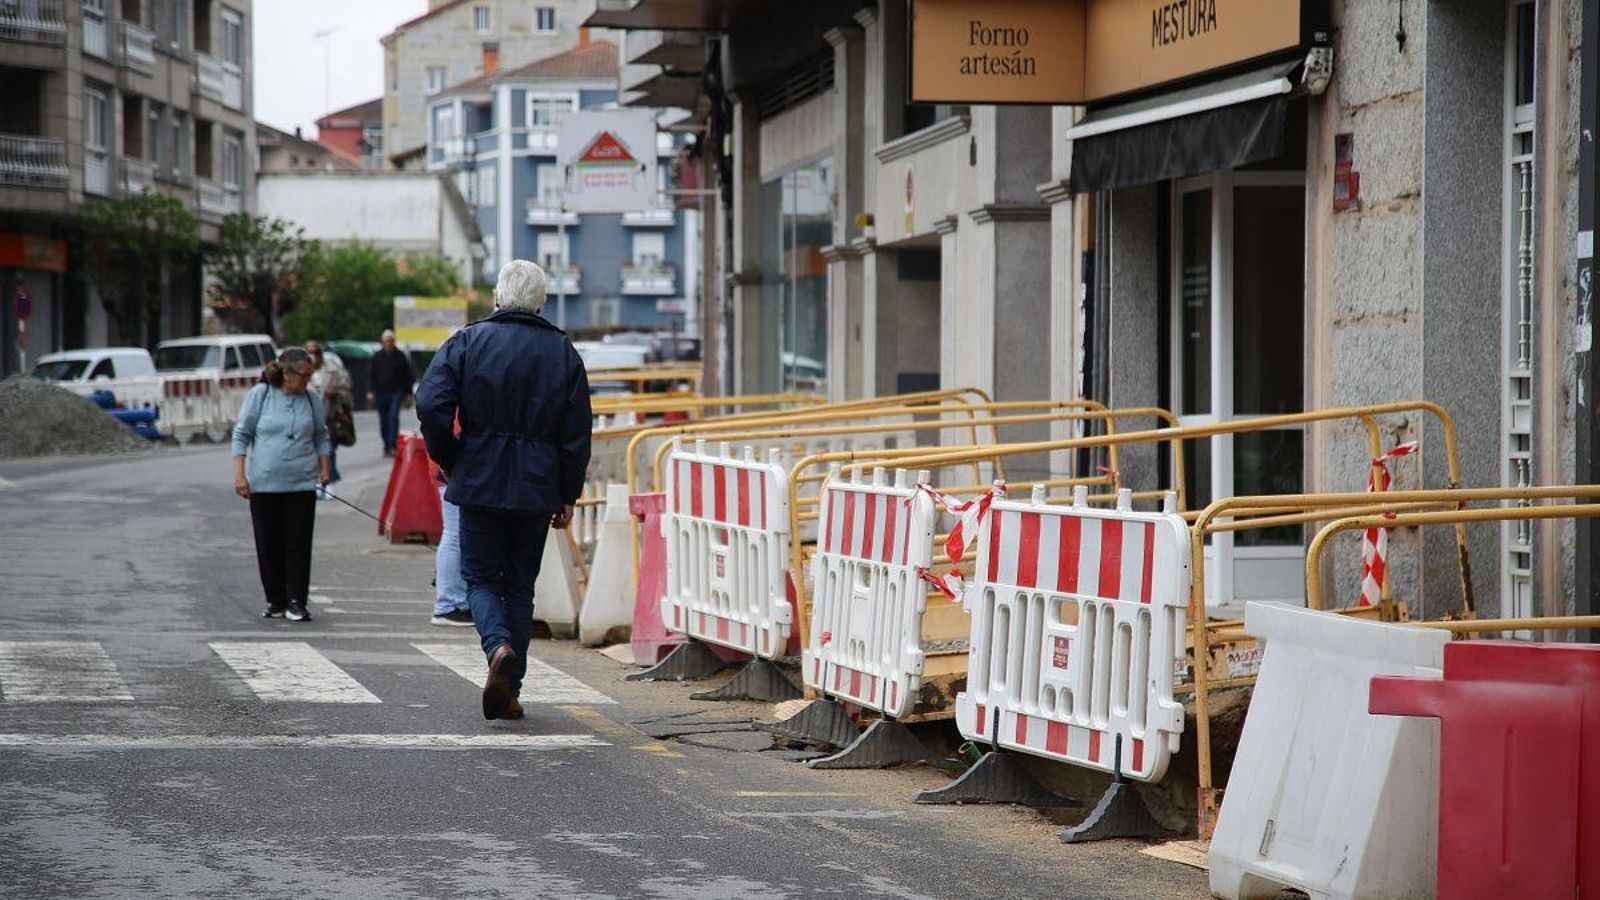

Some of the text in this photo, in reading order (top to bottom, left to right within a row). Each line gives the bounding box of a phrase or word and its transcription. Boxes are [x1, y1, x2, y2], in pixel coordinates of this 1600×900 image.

[969, 20, 1029, 47] Forno
[1152, 0, 1217, 49] MESTURA
[960, 50, 1036, 76] artesán
